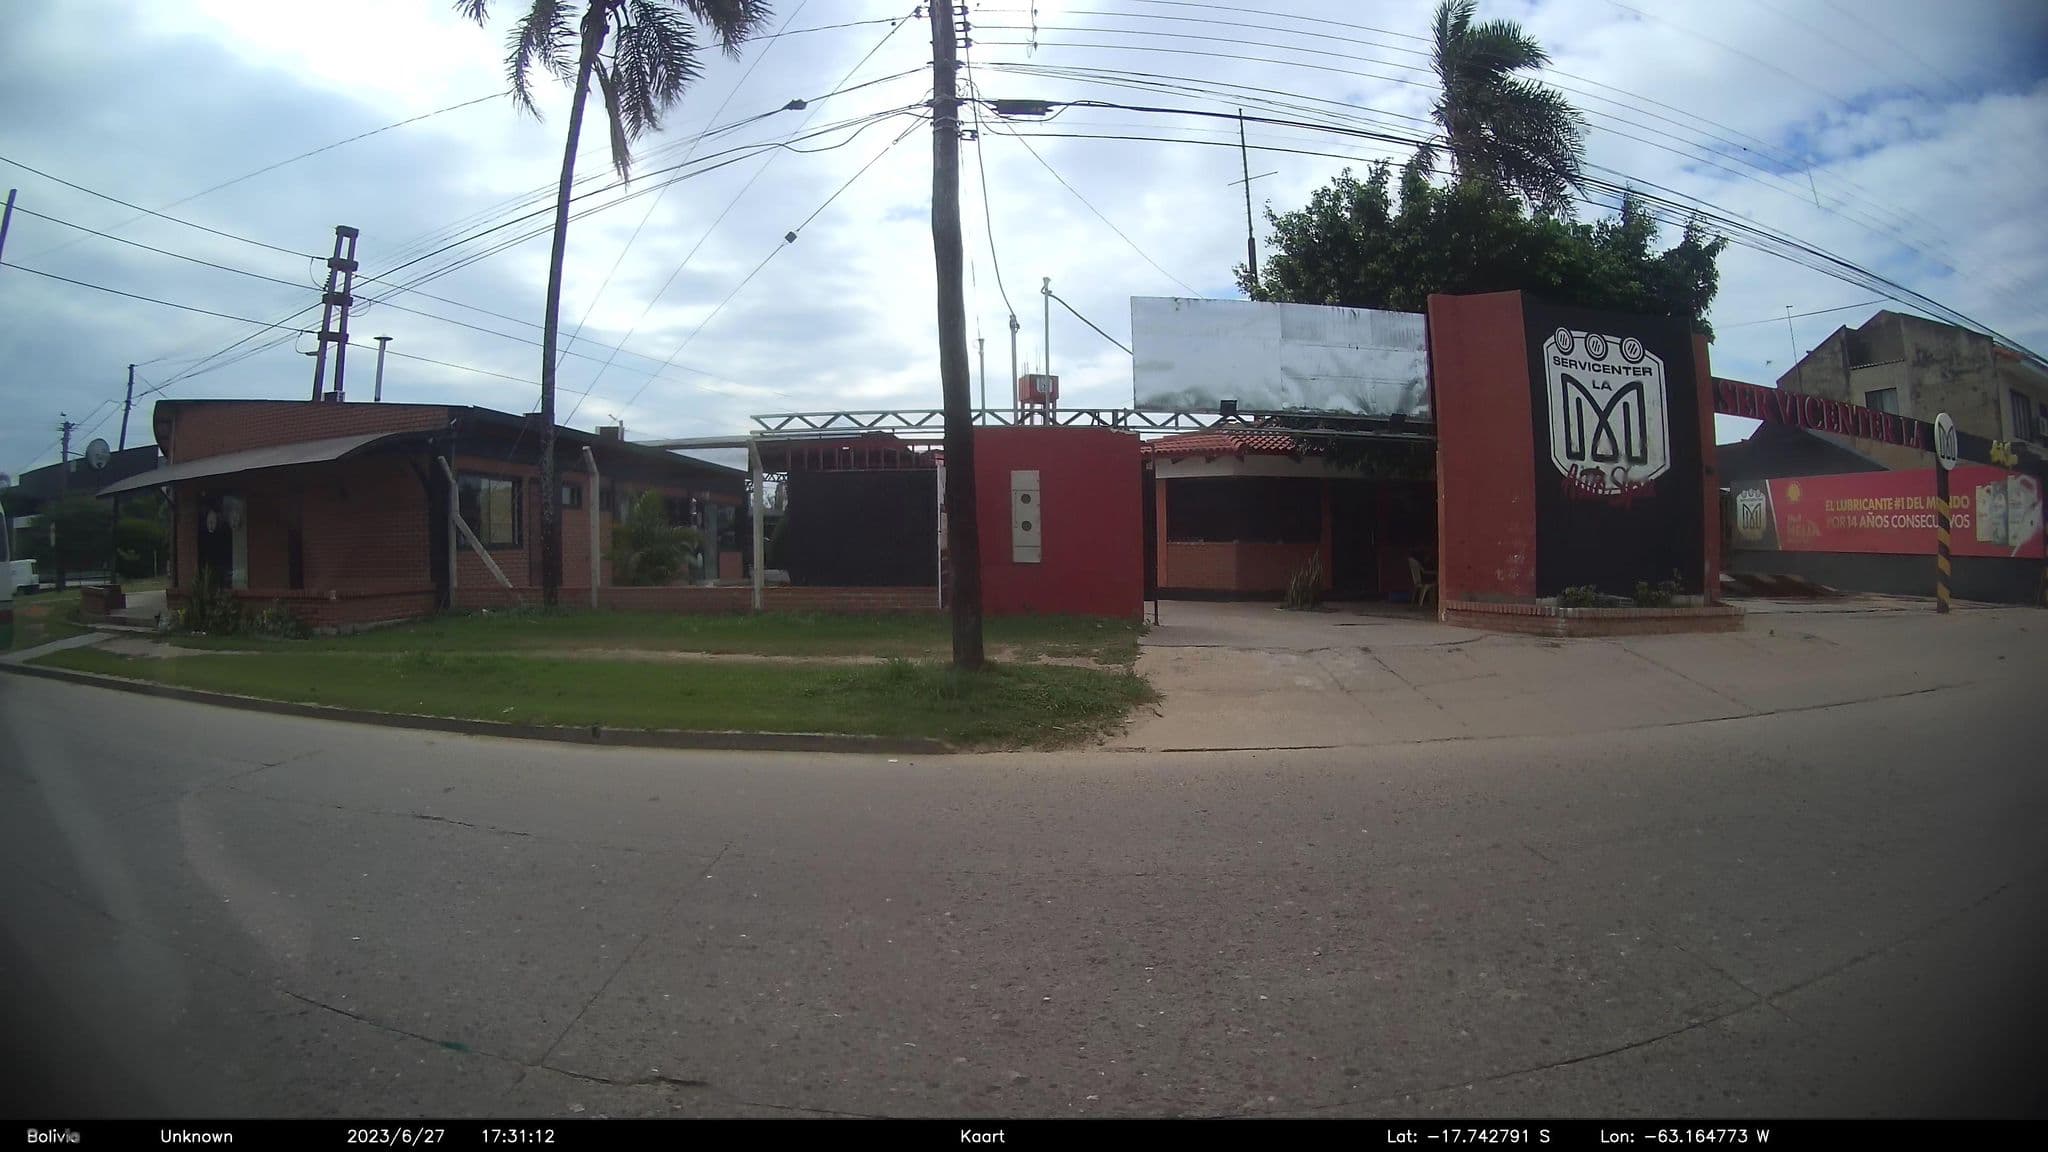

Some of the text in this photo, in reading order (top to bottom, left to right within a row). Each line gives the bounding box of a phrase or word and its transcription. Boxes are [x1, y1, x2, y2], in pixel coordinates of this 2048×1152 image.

[1553, 356, 1653, 377] SERVICENTER
[1592, 379, 1613, 392] LA
[1718, 381, 1923, 449] SERVICENTER LA
[1825, 499, 1837, 511] EL
[1837, 497, 1893, 511] LUBRICANTE
[1894, 498, 1905, 510] #1
[1906, 496, 1924, 510] DEL
[1847, 515, 1858, 528] 14
[1859, 512, 1890, 528] AÑOS
[1891, 514, 1970, 529] CONSECUVOS
